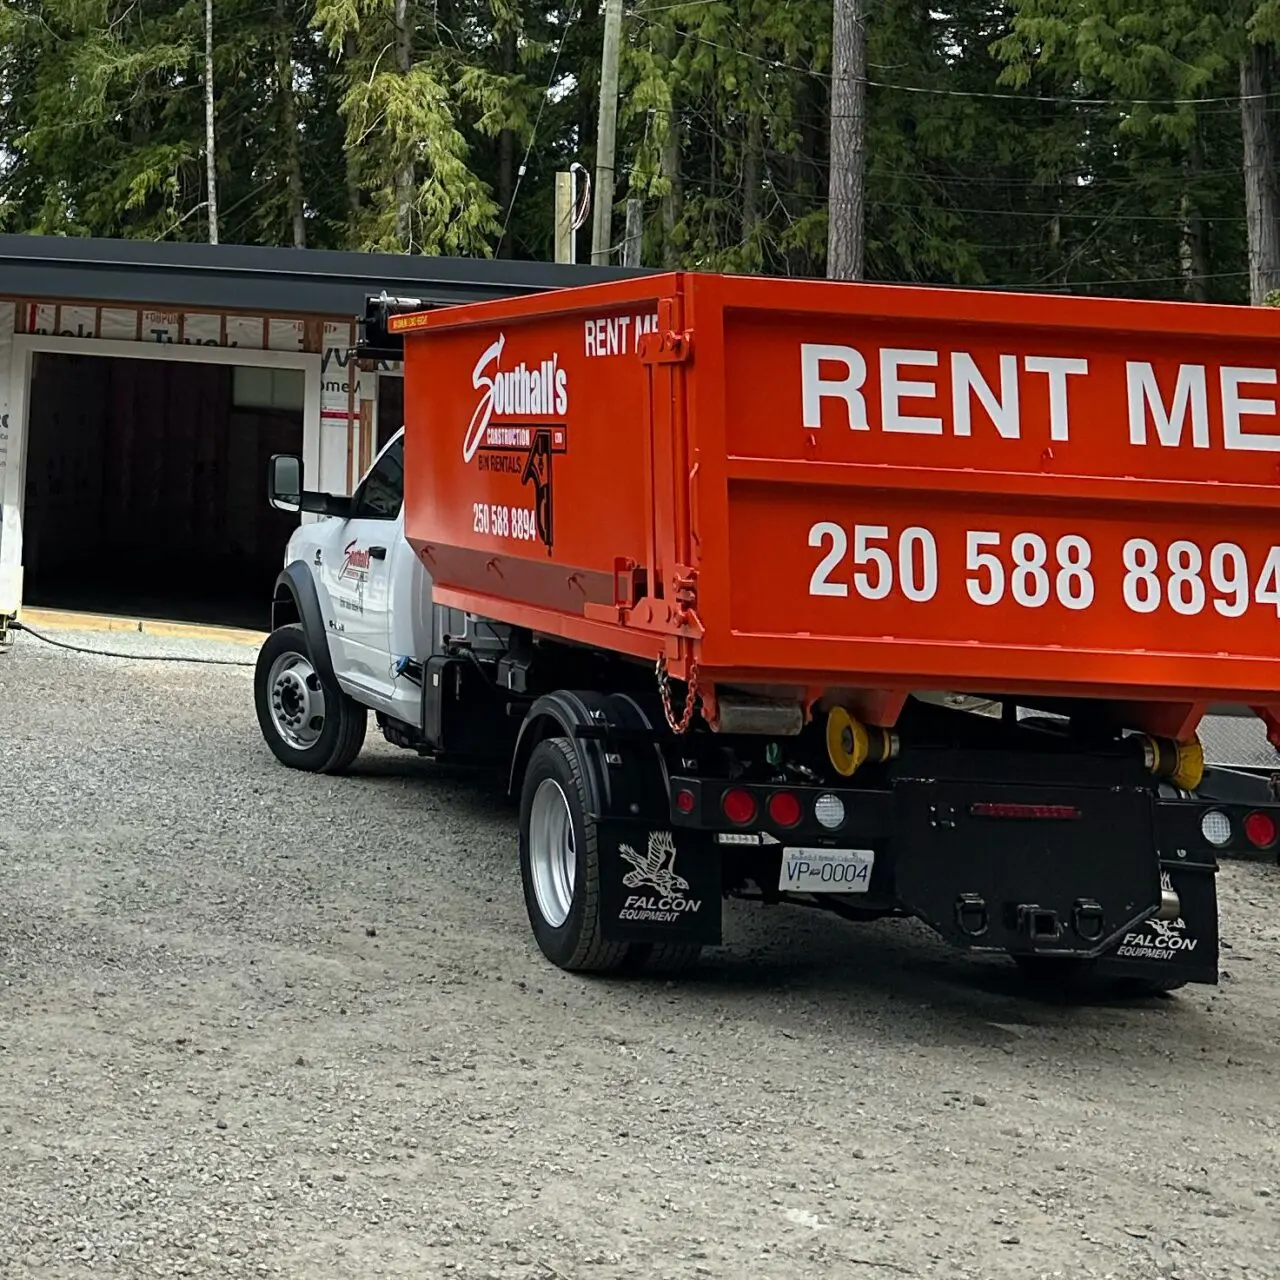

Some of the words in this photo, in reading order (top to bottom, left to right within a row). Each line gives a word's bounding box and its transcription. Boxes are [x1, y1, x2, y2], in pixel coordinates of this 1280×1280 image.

[584, 316, 631, 357] RENT
[463, 332, 567, 463] Southall's
[801, 343, 1088, 442] RENT
[1125, 361, 1280, 452] ME
[486, 428, 530, 447] CONSTRUCTION
[490, 456, 521, 474] RENTALS
[473, 503, 489, 534] 250
[491, 505, 509, 537] 588
[511, 507, 536, 541] 8894
[808, 522, 938, 602] 250
[966, 531, 1095, 610] 588
[1123, 538, 1280, 618] 8894
[624, 896, 701, 912] FALCON
[619, 909, 680, 922] EQUIPMENT
[1122, 933, 1197, 951] FALCON
[1117, 947, 1176, 960] EQUIPMENT
